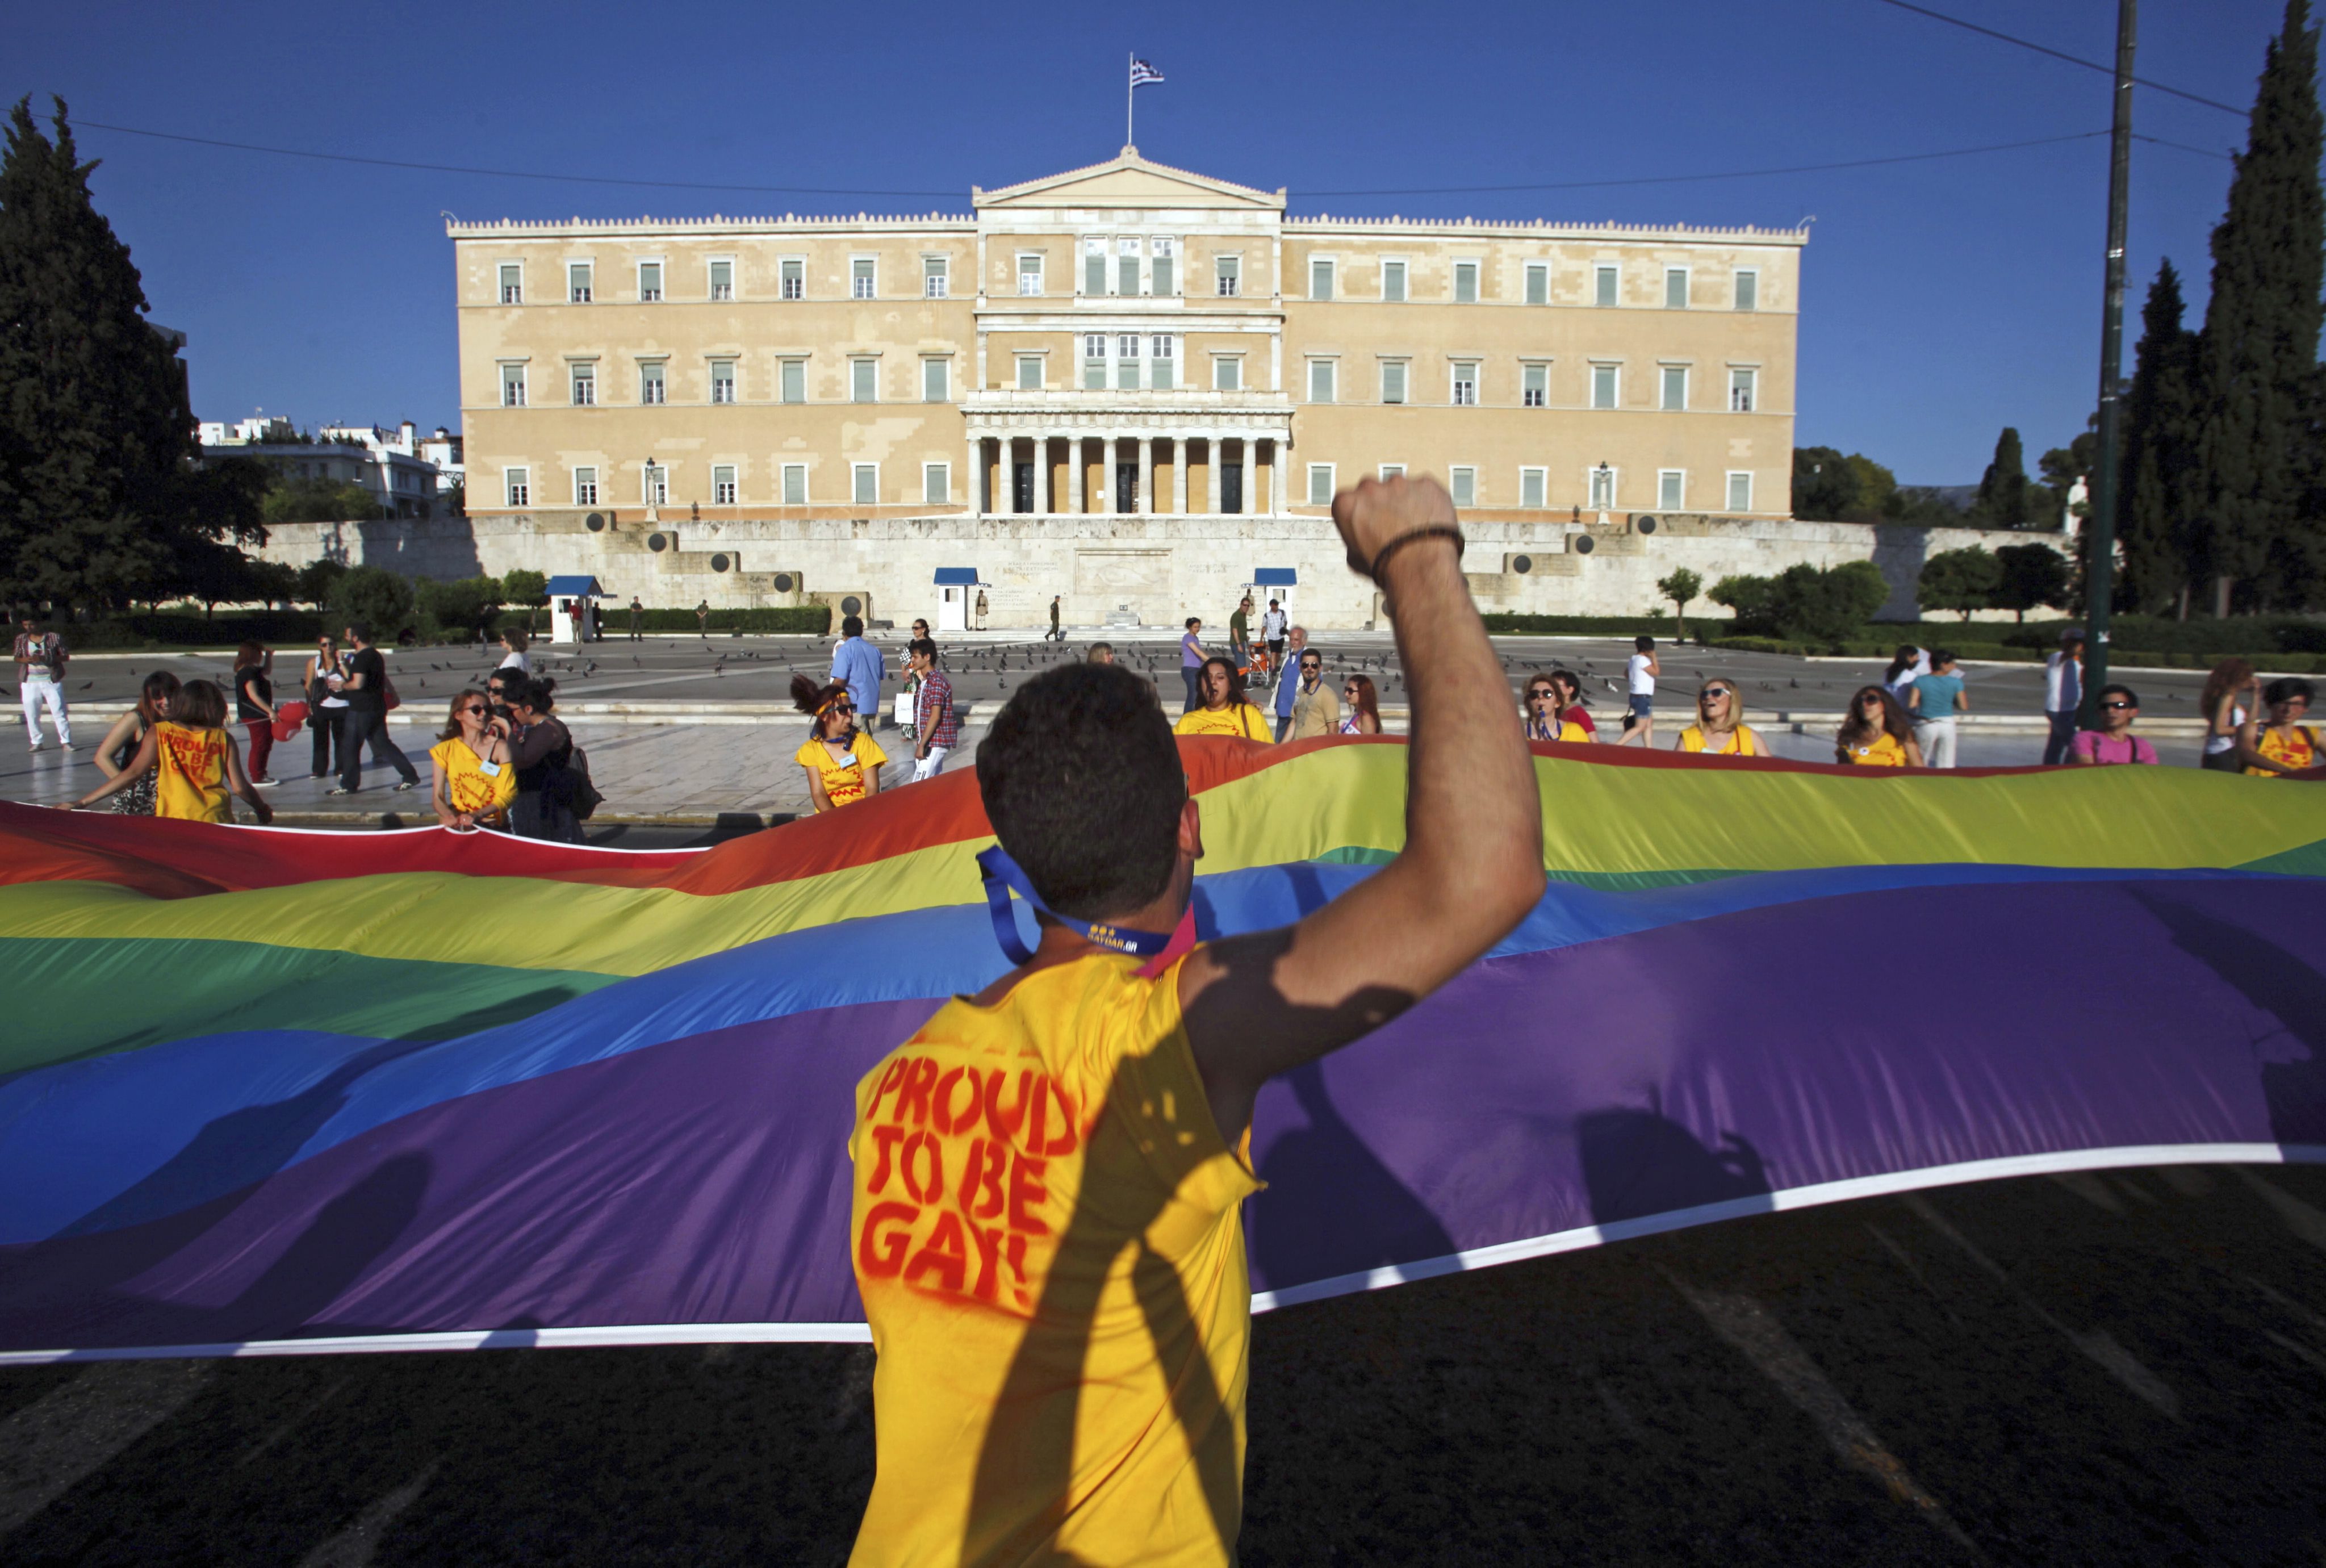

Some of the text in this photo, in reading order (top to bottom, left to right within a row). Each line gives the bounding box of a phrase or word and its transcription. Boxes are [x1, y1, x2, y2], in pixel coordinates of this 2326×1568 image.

[190, 752, 213, 766] BE
[865, 1056, 1078, 1157] PROUD
[867, 1125, 1051, 1236] TO BE
[859, 1201, 1032, 1306] GAY!
